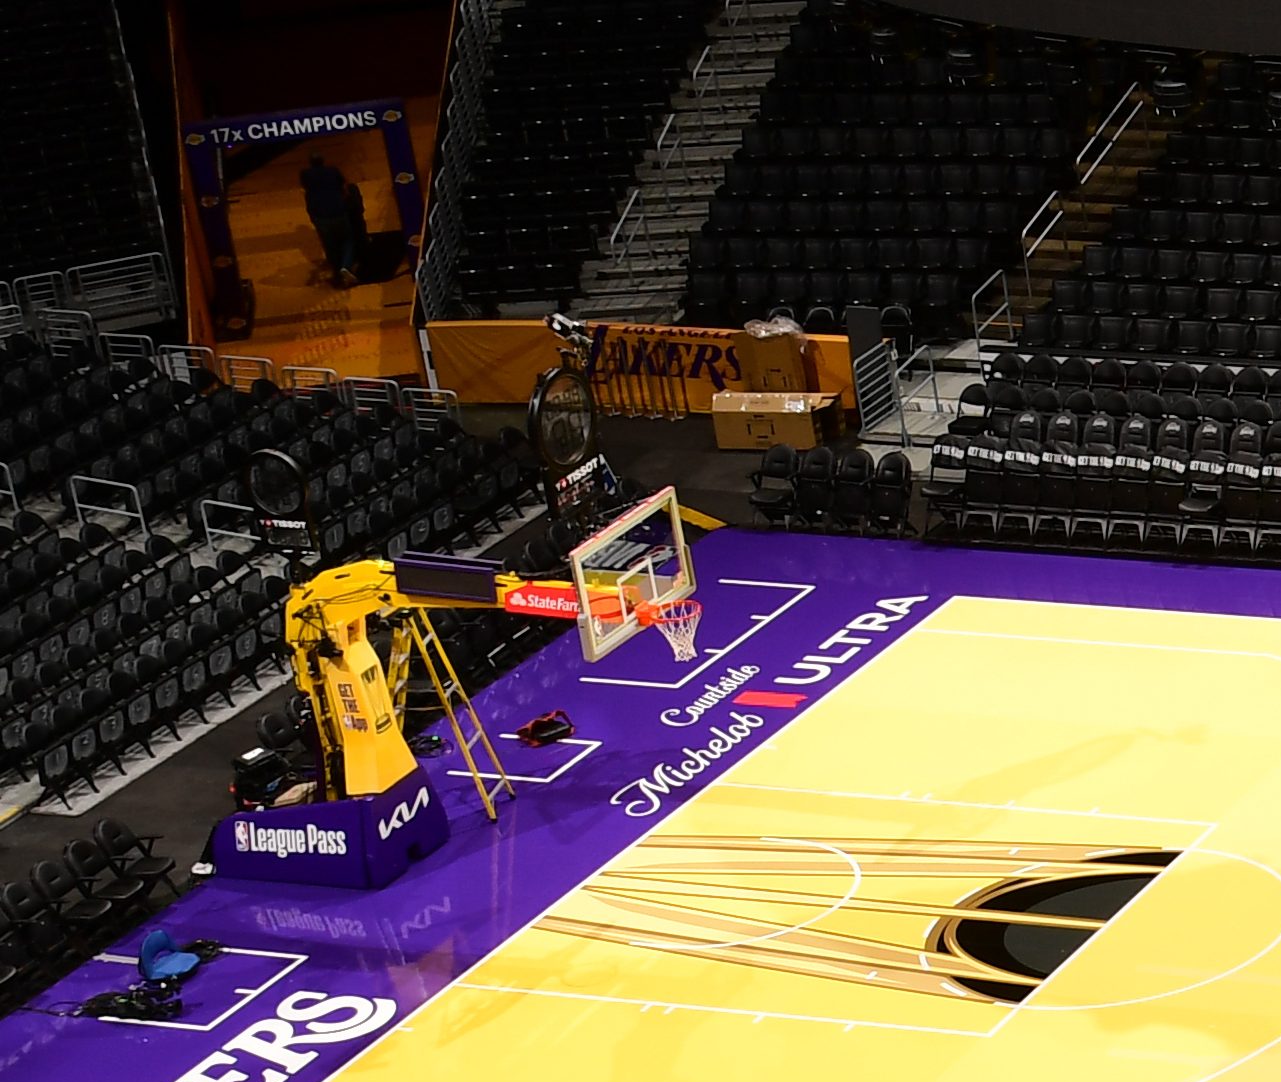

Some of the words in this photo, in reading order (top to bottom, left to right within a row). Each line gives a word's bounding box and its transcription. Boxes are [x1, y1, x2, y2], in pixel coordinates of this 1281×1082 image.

[210, 128, 244, 144] 17x
[247, 111, 377, 140] CHAMPIONS
[565, 456, 599, 485] TISSOT
[272, 520, 307, 530] TISSOT
[774, 595, 930, 686] ULTRA
[661, 663, 761, 728] Courtside
[609, 711, 765, 818] Michelob
[250, 822, 306, 858] League
[308, 823, 347, 856] Pass
